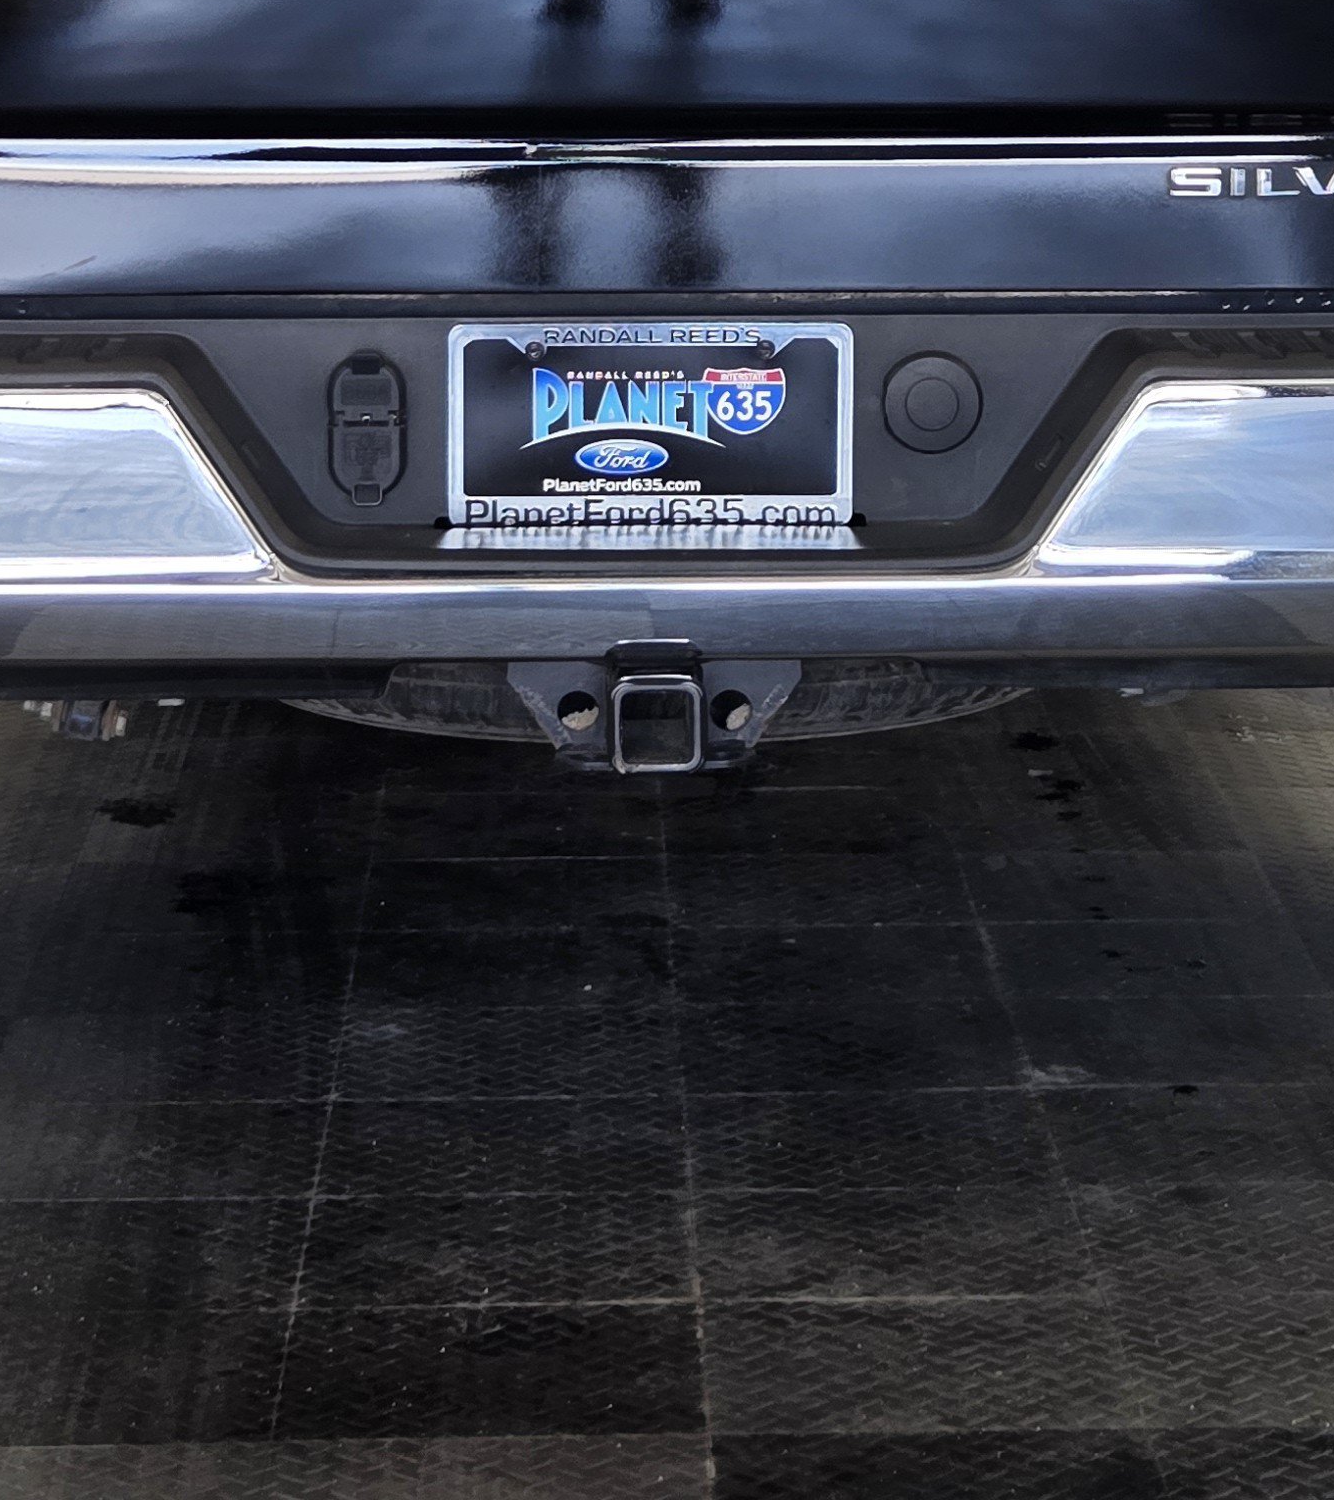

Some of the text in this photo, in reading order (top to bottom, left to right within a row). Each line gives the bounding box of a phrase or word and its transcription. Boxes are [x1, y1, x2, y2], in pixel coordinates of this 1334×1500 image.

[544, 327, 761, 344] RANDALL REED'S
[532, 368, 714, 440] PLANET
[717, 391, 772, 421] 635
[593, 446, 651, 470] Ford
[543, 477, 701, 493] PlanetFord635.com
[466, 500, 836, 525] PlanetFord635.com
